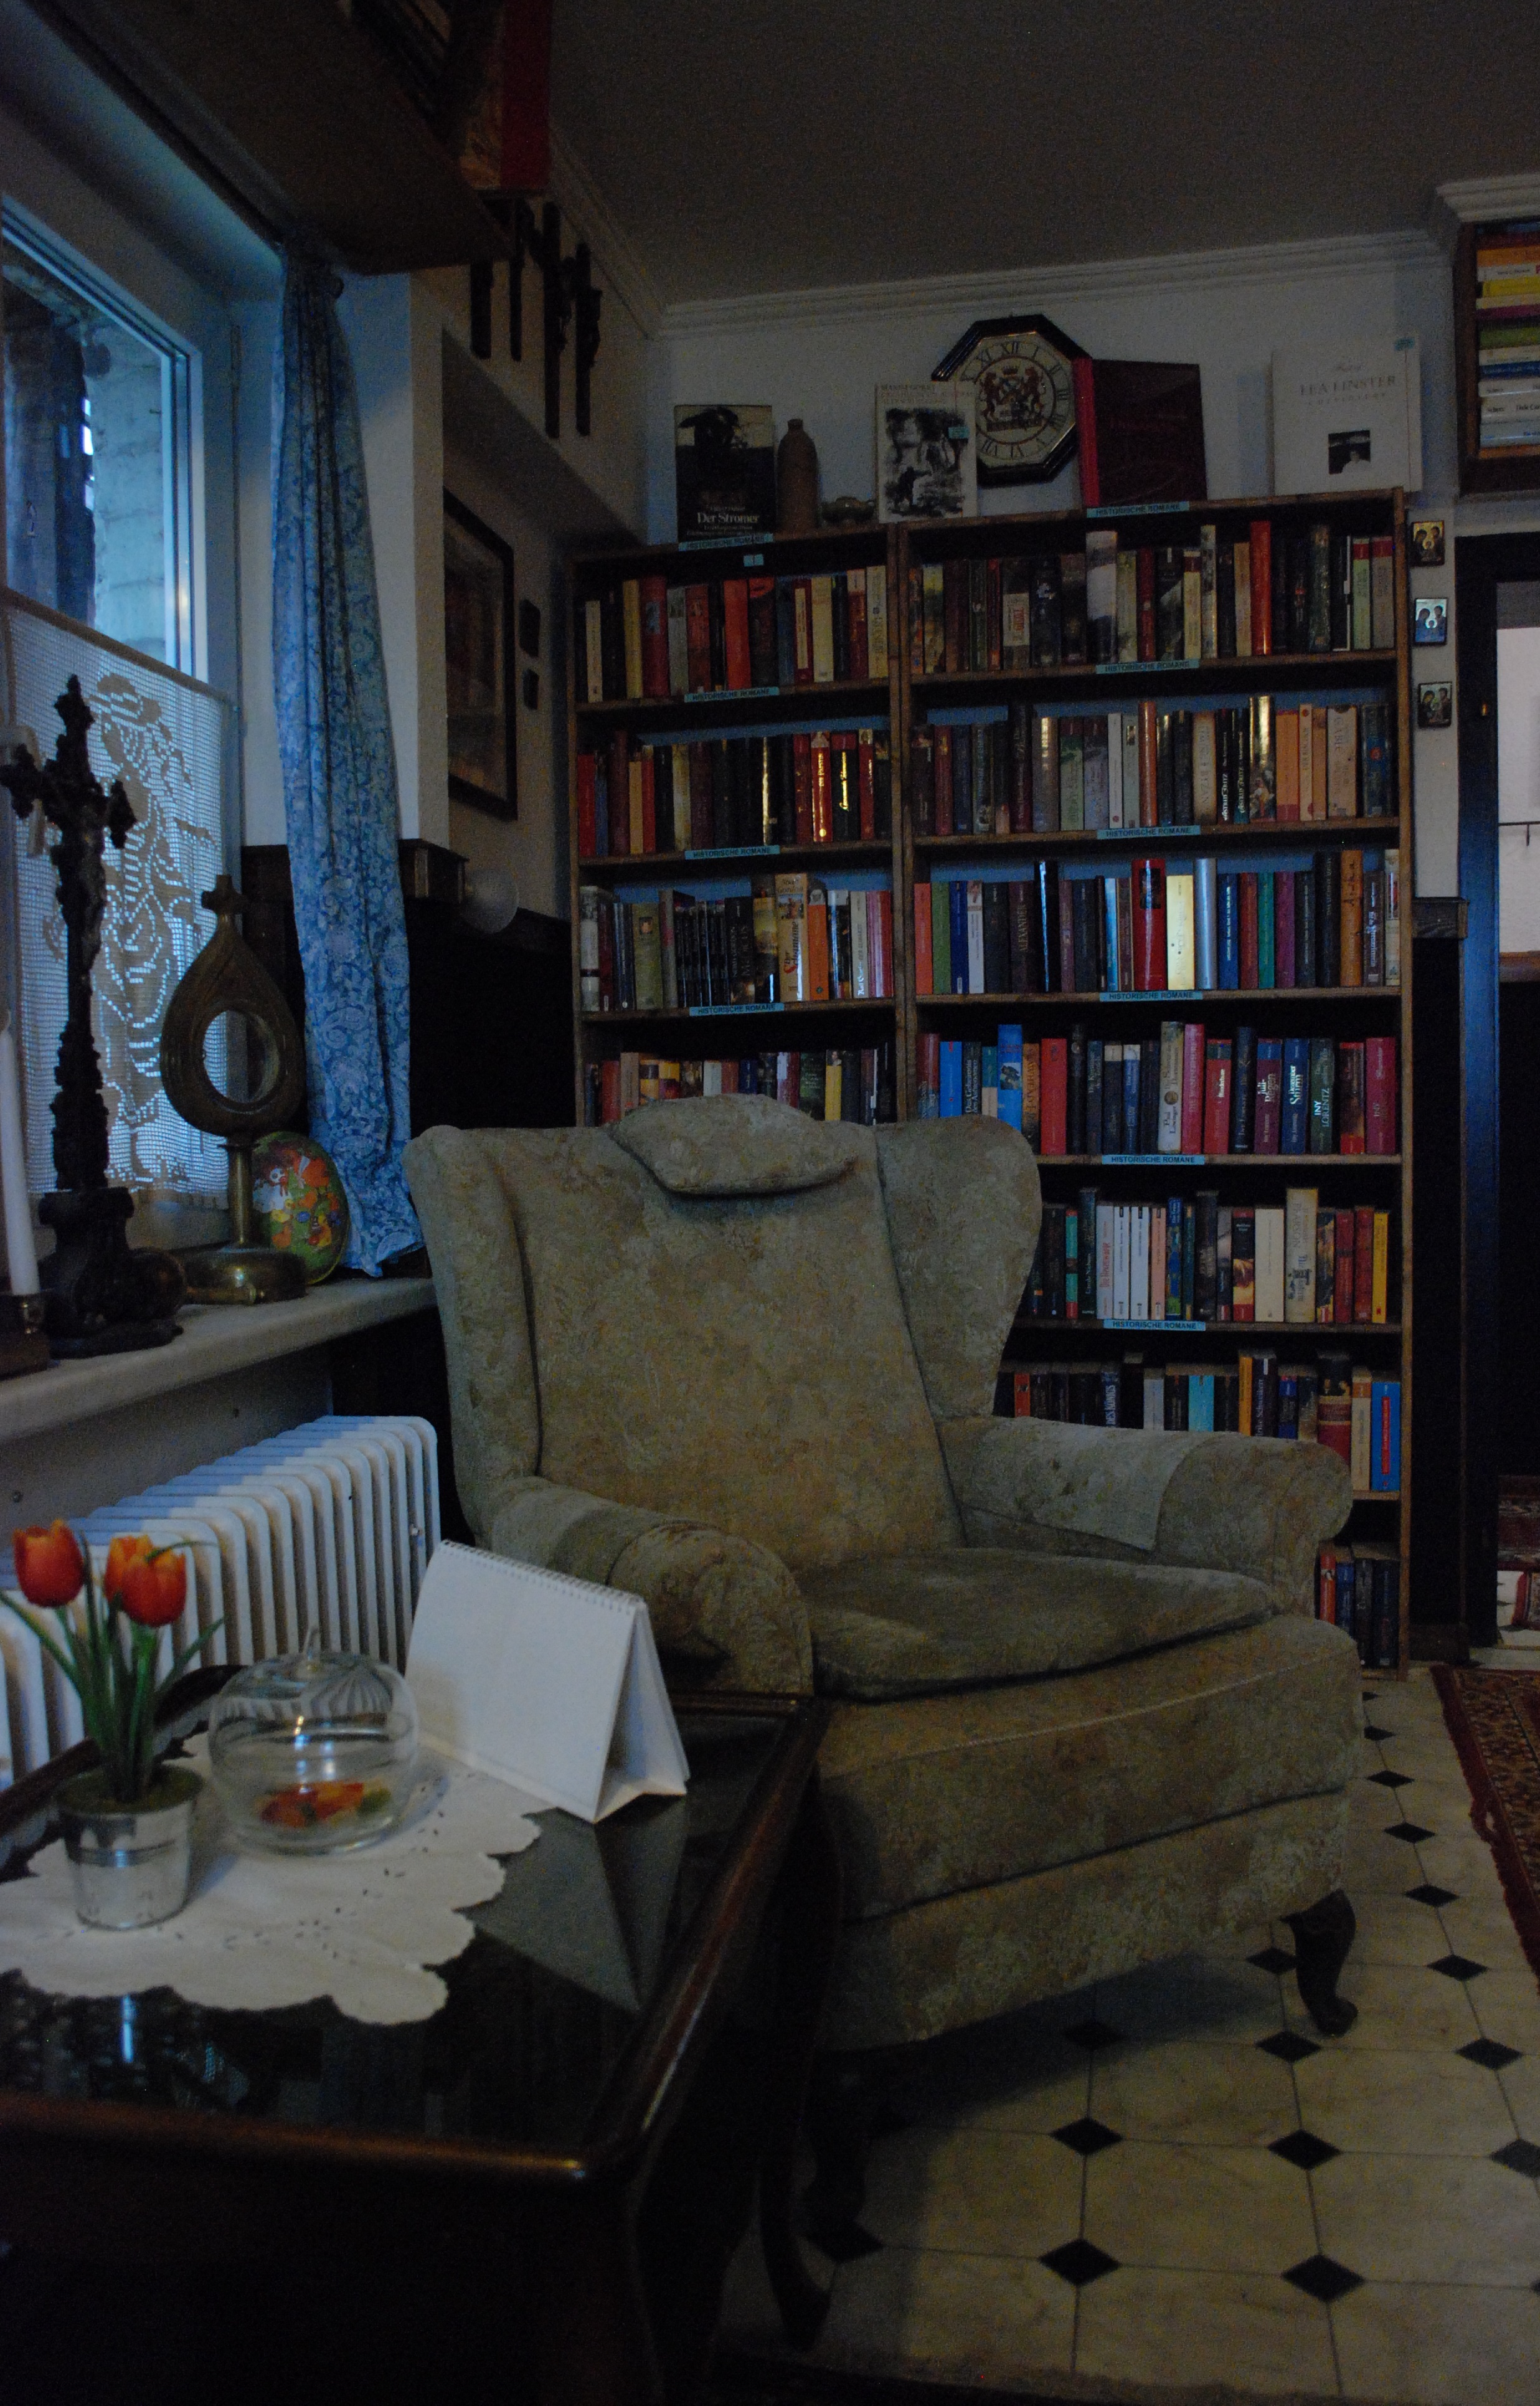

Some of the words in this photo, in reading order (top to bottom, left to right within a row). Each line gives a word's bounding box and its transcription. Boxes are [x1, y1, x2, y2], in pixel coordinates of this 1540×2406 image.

[697, 511, 716, 524] Der
[1107, 828, 1156, 838] HISTORISCHE
[1160, 826, 1192, 836] ROMANE
[693, 848, 739, 858] HISTORISCHE
[741, 845, 771, 854] ROMANE
[1017, 903, 1028, 952] ALEXANDER
[1109, 992, 1158, 1000] HISTORISCHE
[1161, 990, 1194, 998] ROMANE
[698, 1005, 744, 1014] HISTORISCHE
[746, 1003, 776, 1011] ROMANE
[1264, 1073, 1278, 1103] Regen
[1313, 1100, 1321, 1116] INY
[1321, 1087, 1330, 1127] LORENTZ
[1113, 1320, 1162, 1329] HISTORISCHE
[1164, 1321, 1196, 1330] ROMANE
